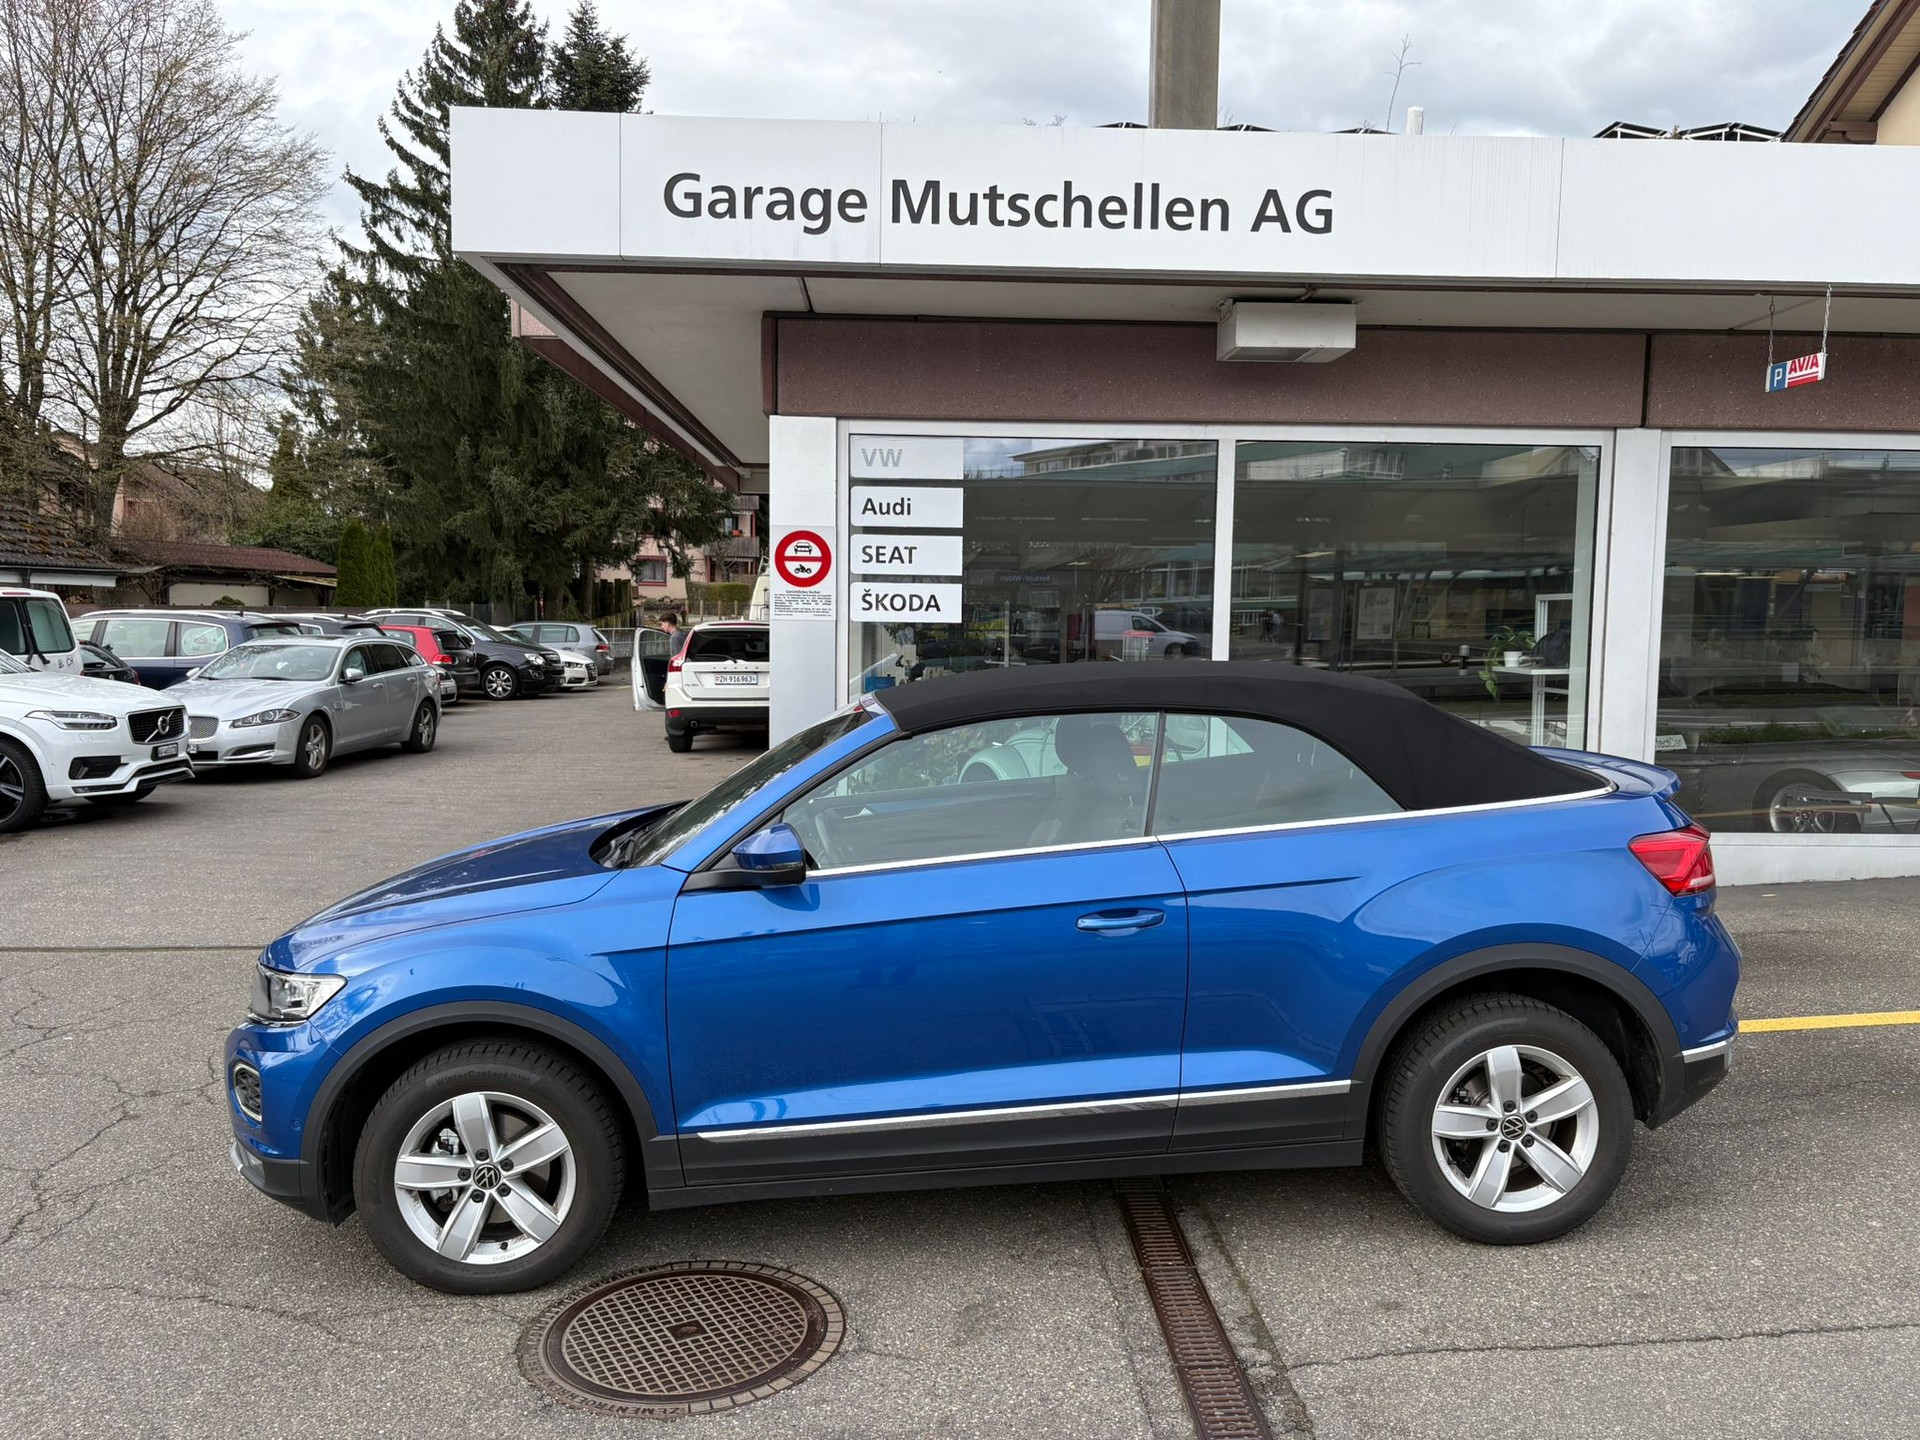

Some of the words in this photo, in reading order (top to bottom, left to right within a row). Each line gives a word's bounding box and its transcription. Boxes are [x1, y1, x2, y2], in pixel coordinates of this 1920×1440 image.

[664, 172, 867, 234] Garage
[892, 179, 1229, 231] Mutschellen
[1250, 189, 1333, 234] AG
[1788, 354, 1819, 374] AVIA
[1774, 368, 1783, 387] P
[861, 448, 903, 467] VW
[861, 497, 912, 516] Audi
[861, 546, 918, 564] SEAT
[861, 589, 941, 612] ŠKODA
